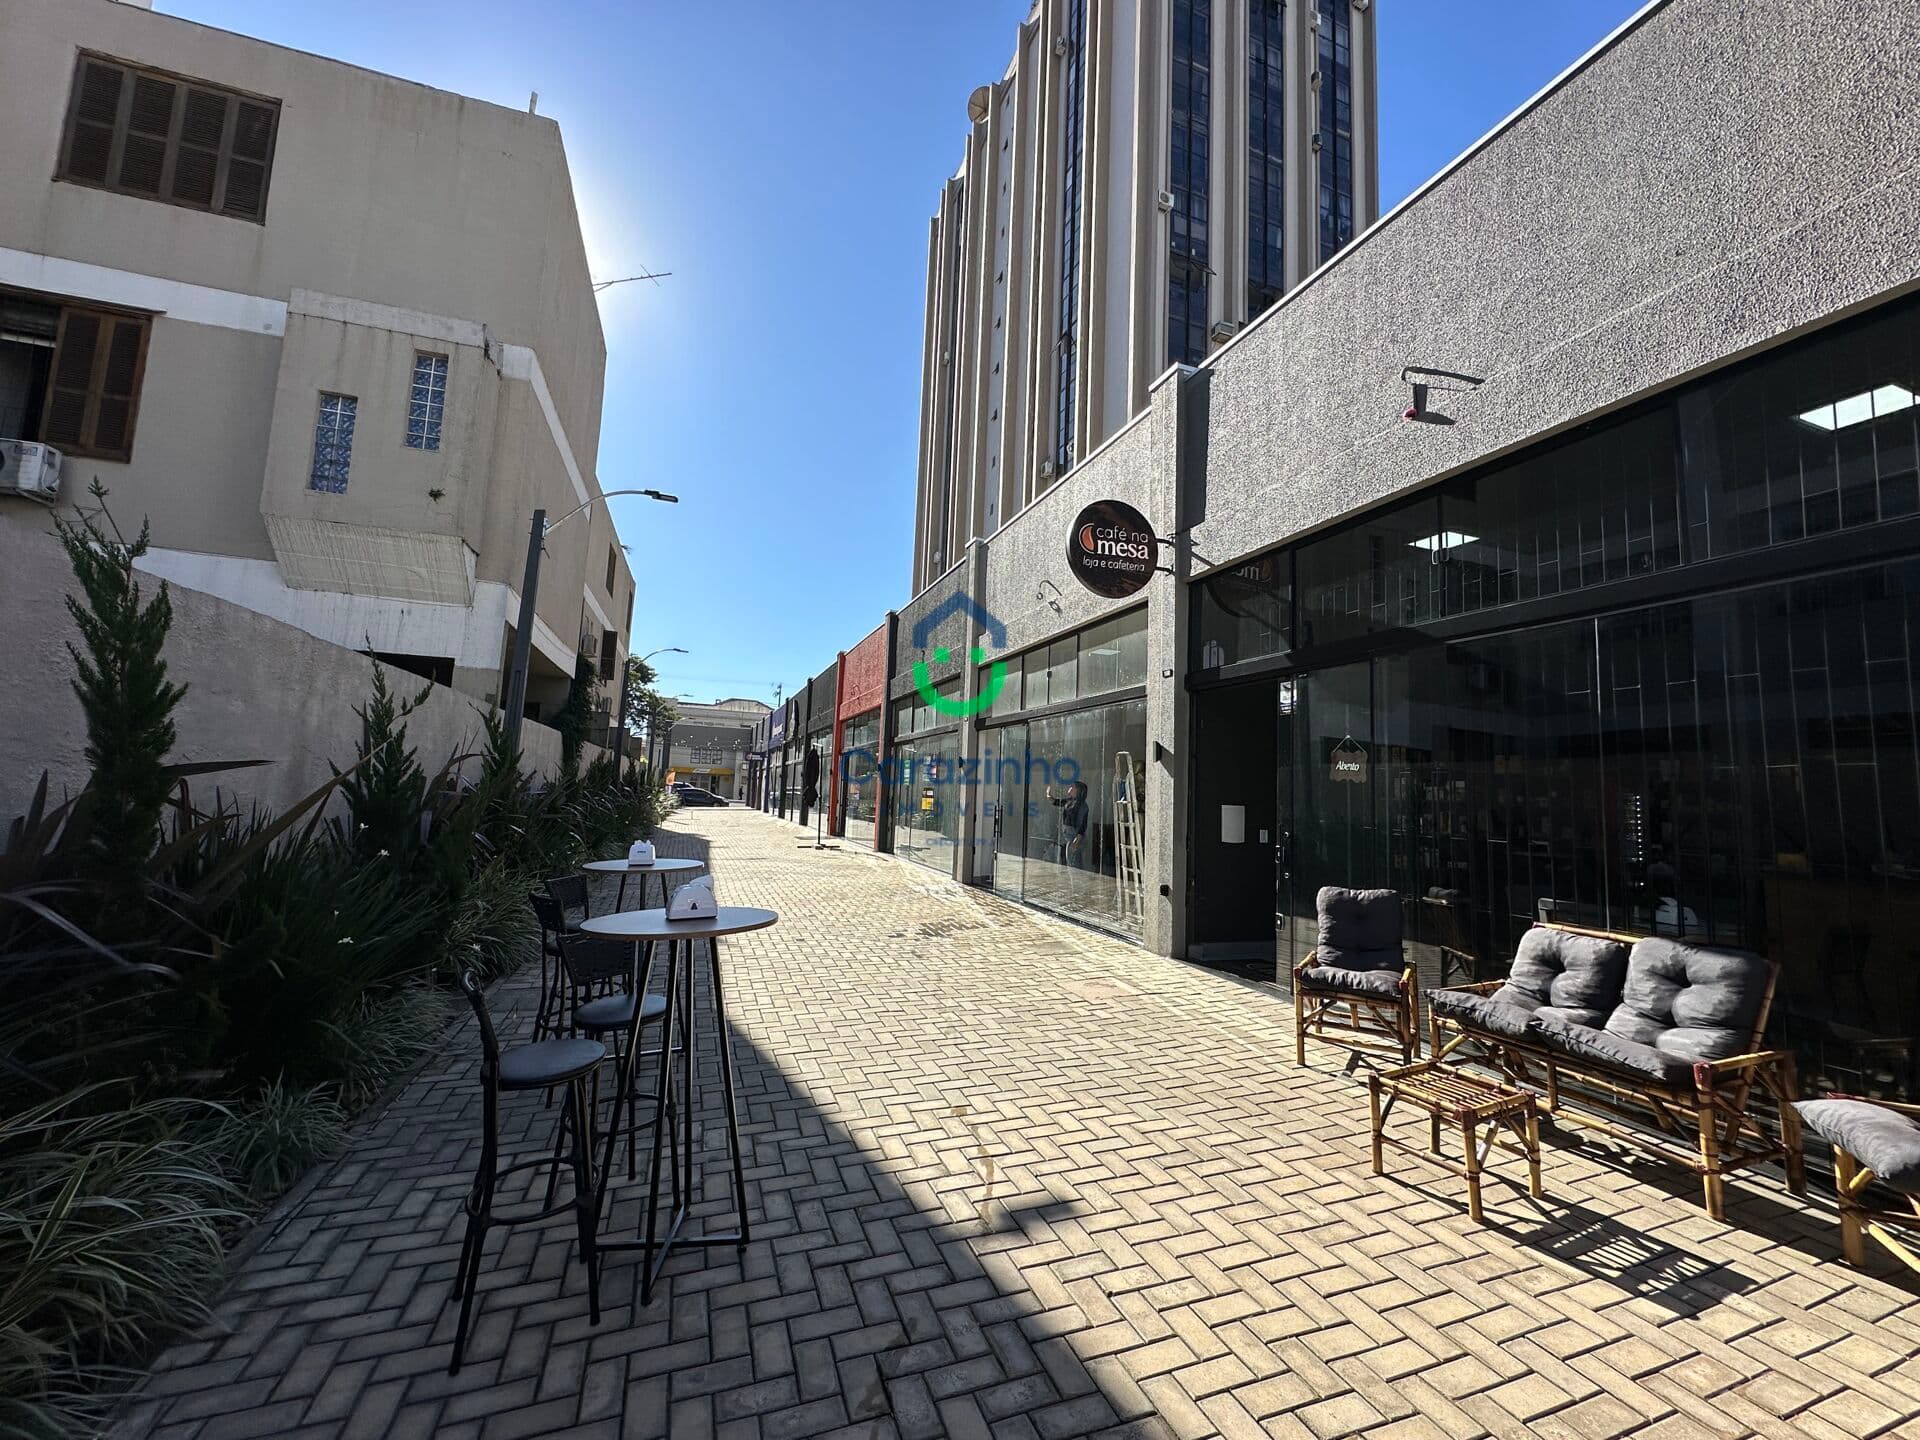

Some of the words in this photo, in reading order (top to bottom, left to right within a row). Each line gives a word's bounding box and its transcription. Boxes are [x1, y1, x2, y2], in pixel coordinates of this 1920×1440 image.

[1096, 525, 1127, 541] café
[1131, 532, 1149, 543] na
[1096, 540, 1149, 560] mesa
[1082, 555, 1099, 568] loja
[1100, 560, 1107, 568] e
[1107, 559, 1145, 572] cafeteria
[1335, 760, 1360, 771] Aberto
